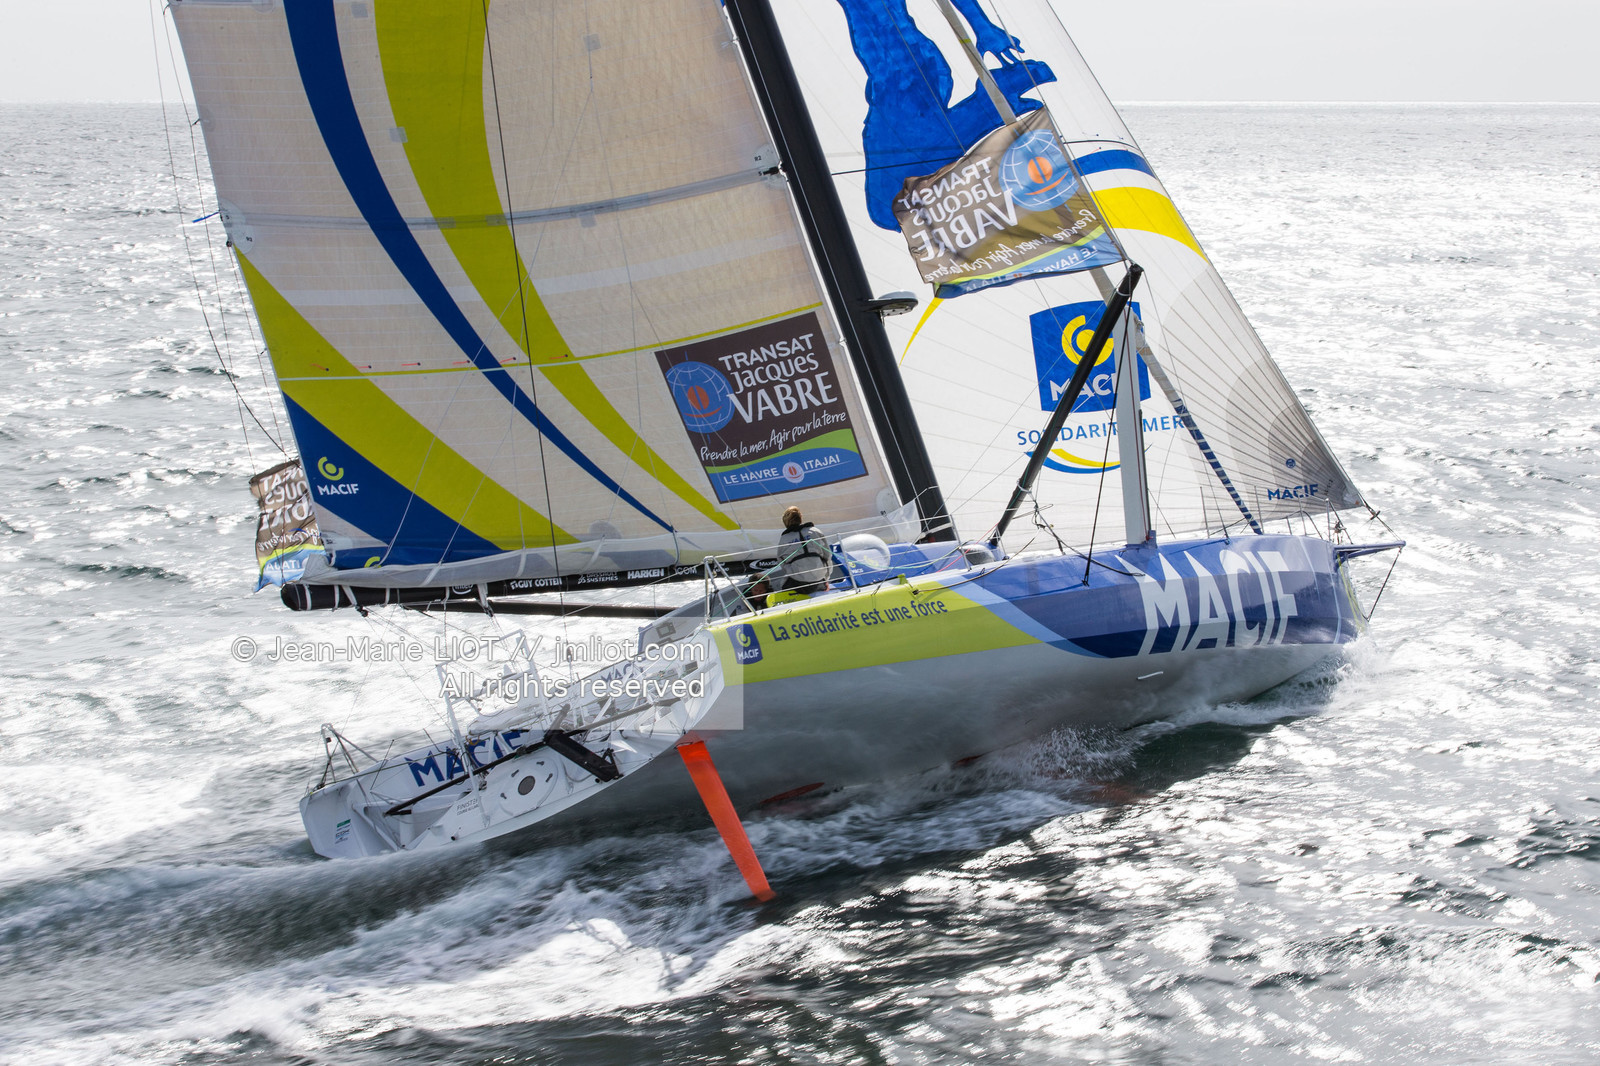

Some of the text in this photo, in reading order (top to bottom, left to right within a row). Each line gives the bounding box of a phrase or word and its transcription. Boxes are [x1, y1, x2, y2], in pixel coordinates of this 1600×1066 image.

[719, 334, 813, 371] TRANSAT
[726, 371, 838, 424] VABRE
[1143, 415, 1184, 432] MER
[700, 446, 738, 461] Prendre
[769, 428, 791, 450] Agir
[723, 454, 840, 485] LE HAVRE ITAJAI
[317, 484, 359, 496] MACIF
[1267, 484, 1319, 500] MACIF
[518, 577, 562, 588] GUY COTTEN
[627, 568, 664, 580] HARKEN
[1114, 550, 1298, 656] MACIF
[768, 600, 948, 642] La solidarité est une force
[737, 648, 759, 660] MACIF
[404, 730, 523, 787] MACIF
